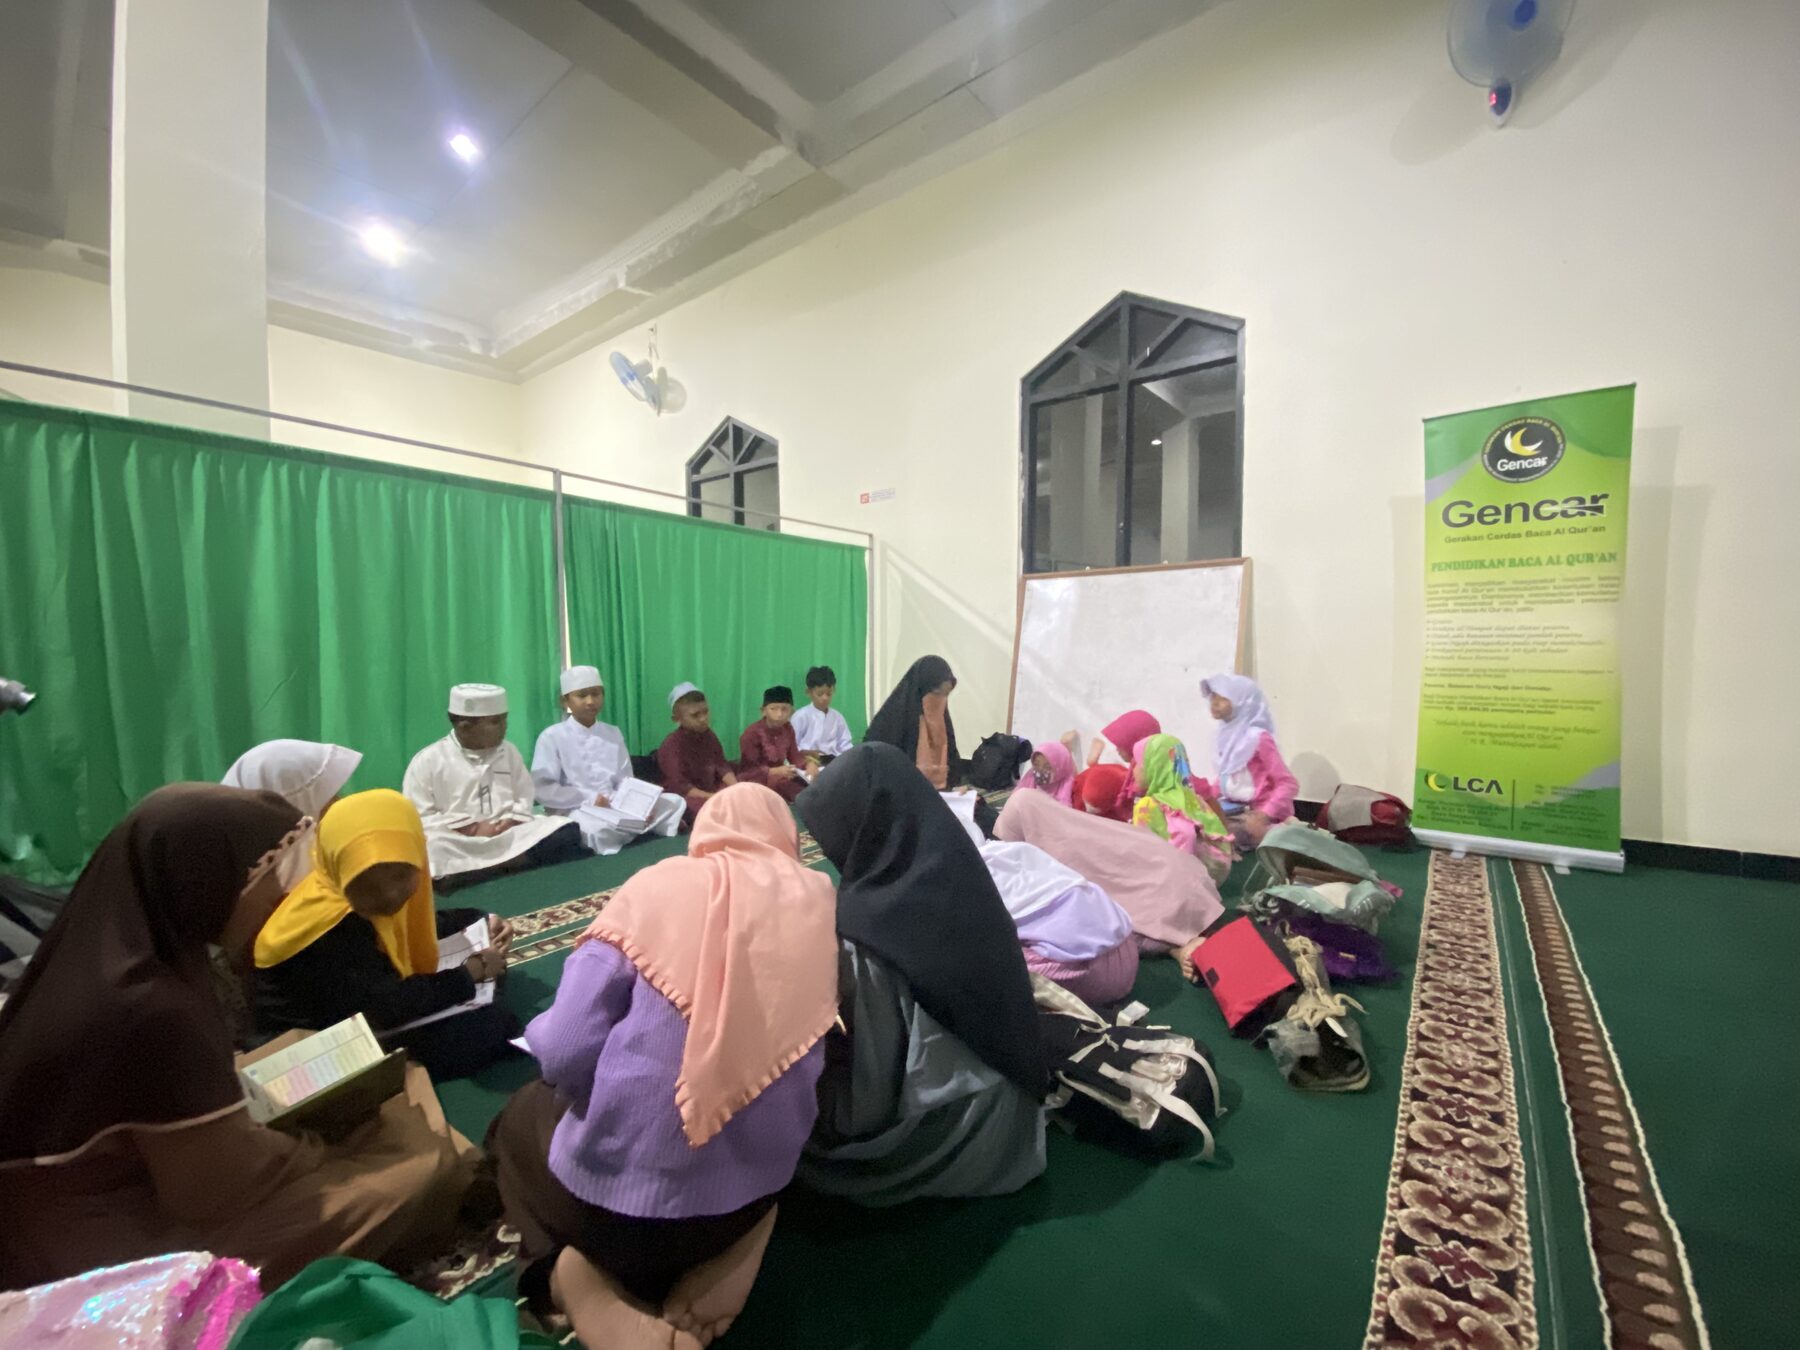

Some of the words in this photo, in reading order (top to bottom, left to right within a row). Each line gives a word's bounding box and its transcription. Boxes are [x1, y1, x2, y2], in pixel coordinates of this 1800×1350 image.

[1496, 456, 1548, 471] Gencar
[1441, 493, 1610, 528] Gencar
[1444, 534, 1484, 543] Gerakan
[1487, 532, 1522, 540] Cerdas
[1525, 529, 1551, 538] Baca
[1431, 558, 1506, 572] PENDIDIKAN
[1508, 556, 1542, 568] BACA
[1546, 556, 1562, 566] AL
